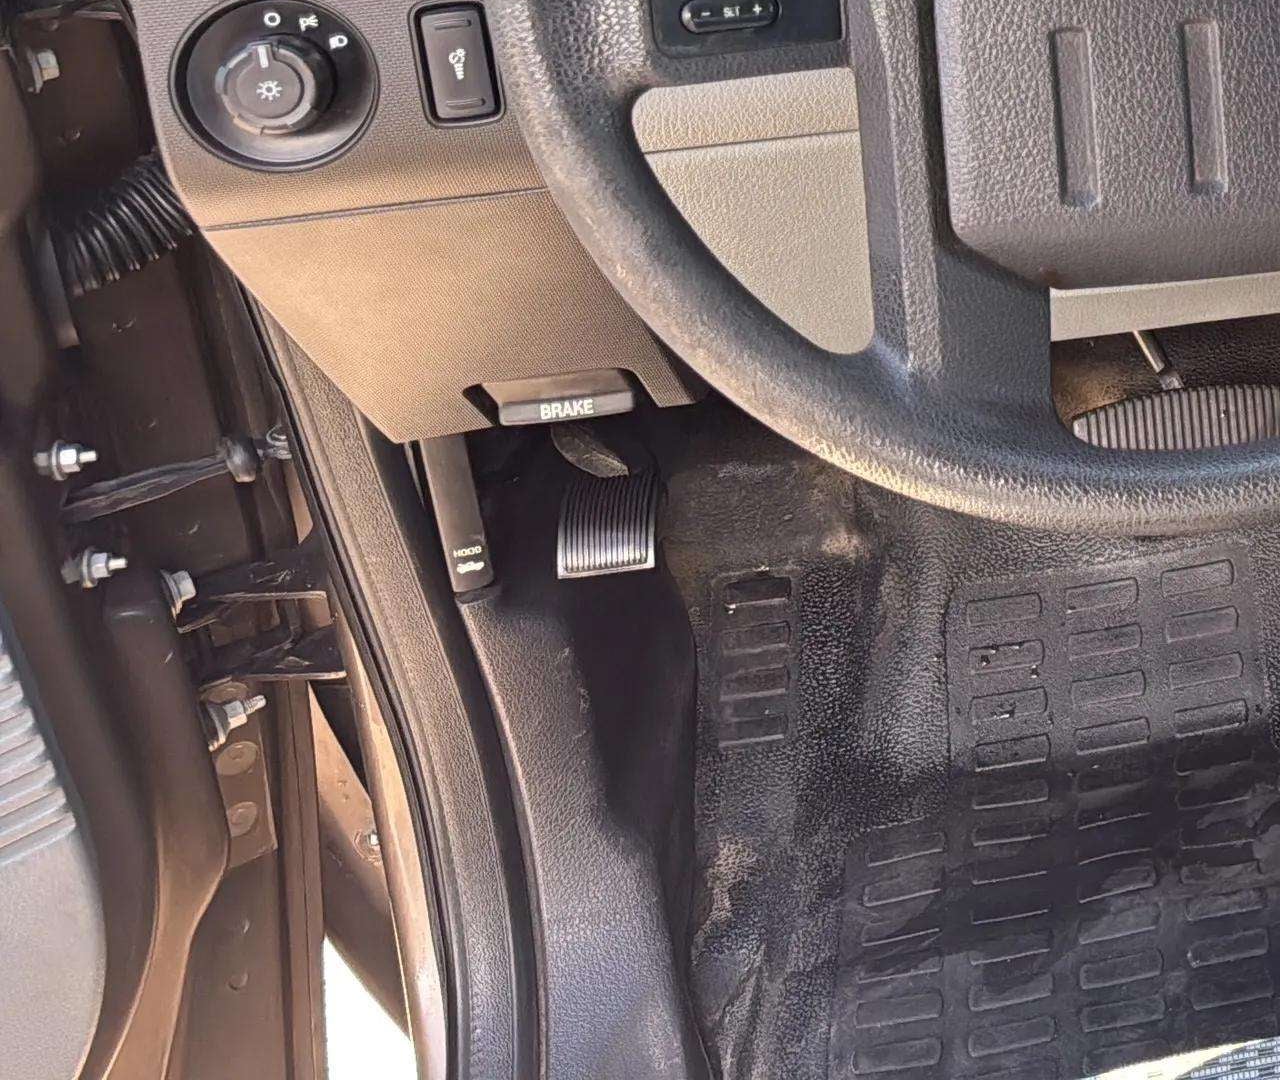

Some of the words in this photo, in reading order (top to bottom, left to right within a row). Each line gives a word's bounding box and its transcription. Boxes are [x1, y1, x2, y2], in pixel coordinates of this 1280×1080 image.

[723, 6, 740, 18] SET
[540, 399, 593, 420] BRAKE
[453, 546, 482, 558] HOOD
